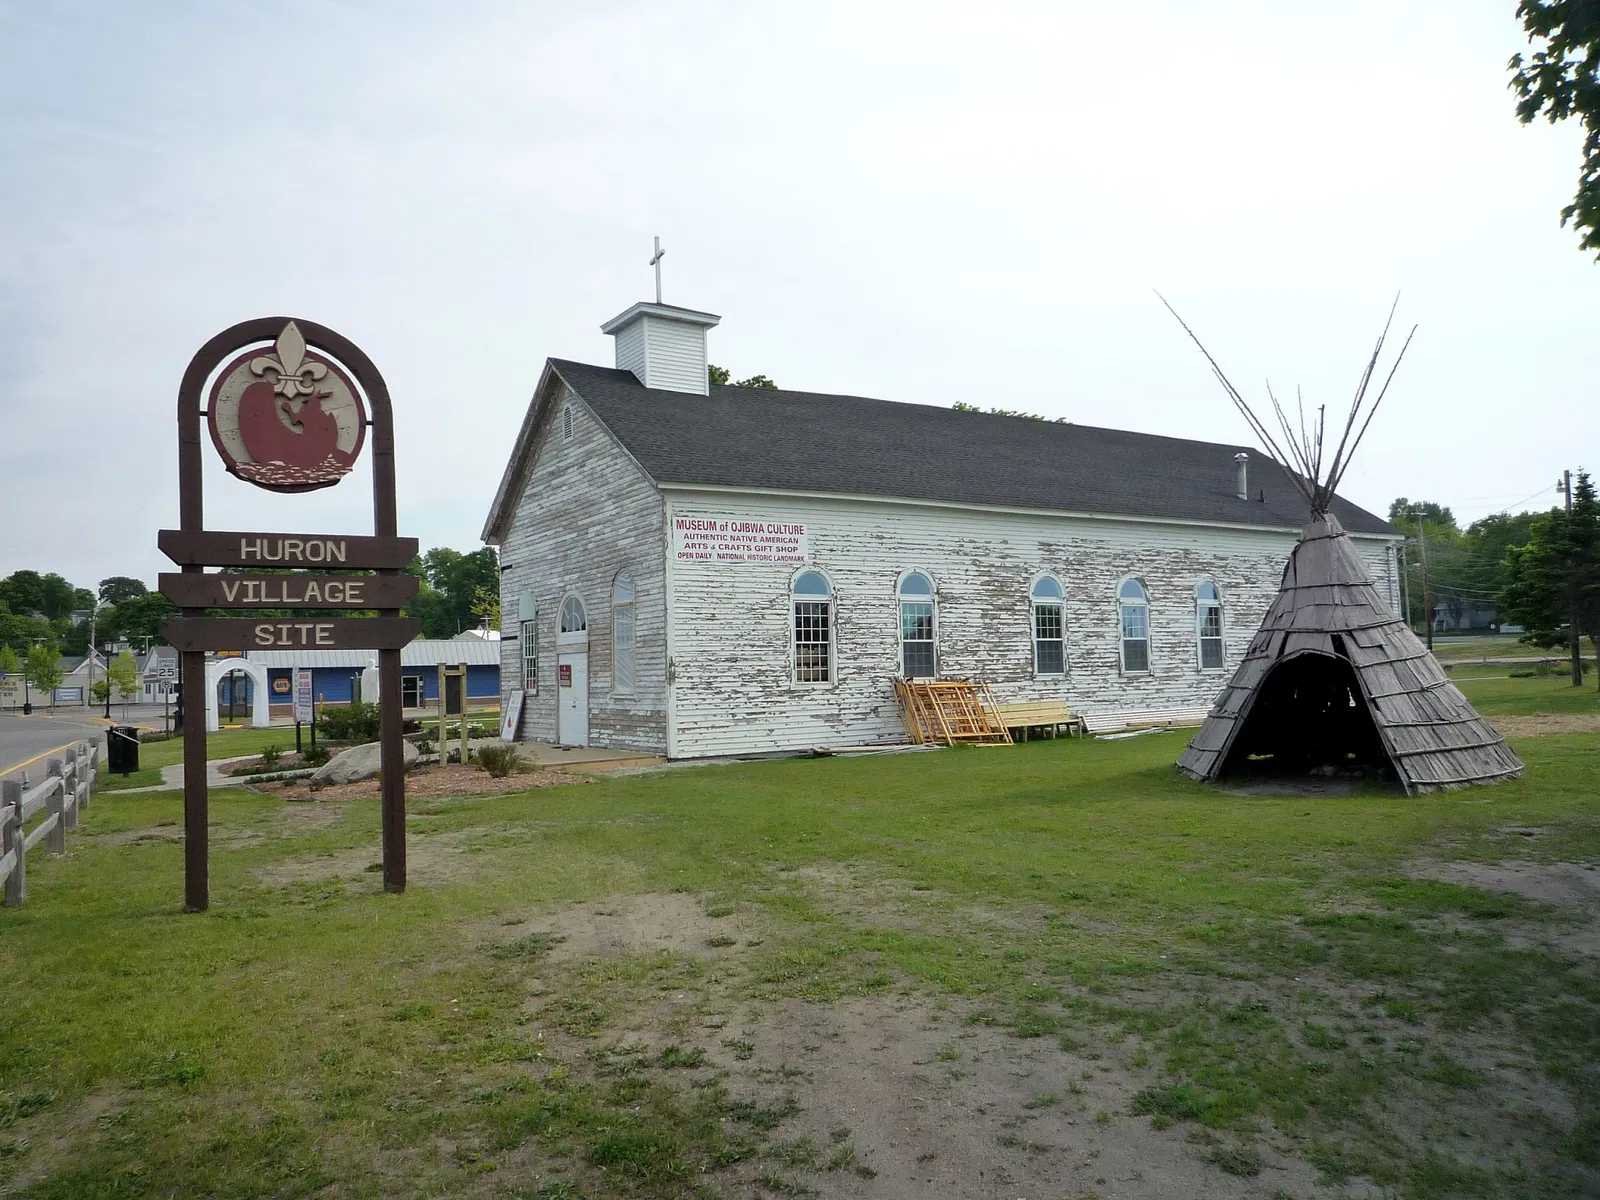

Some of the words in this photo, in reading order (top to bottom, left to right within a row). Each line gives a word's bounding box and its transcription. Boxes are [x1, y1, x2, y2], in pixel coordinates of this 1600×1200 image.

[676, 519, 717, 531] MUSEUM
[719, 521, 729, 532] of
[731, 521, 765, 534] OJIBWA
[767, 523, 805, 536] CULTURE
[683, 532, 728, 541] AUTHENTIC
[729, 533, 758, 543] NATIVE
[759, 535, 799, 544] AMERICAN
[240, 538, 346, 562] HURON
[684, 542, 708, 550] ARTS
[718, 543, 752, 552] CRAFTS
[775, 545, 799, 553] SHOP
[677, 551, 694, 560] OPEN
[695, 551, 712, 560] DAILY
[716, 552, 746, 561] NATIONAL
[747, 554, 773, 562] HISTORIC
[773, 555, 805, 563] LANDMARK
[221, 580, 365, 603] VILLAGE
[254, 623, 335, 645] SITE
[158, 668, 175, 677] 25
